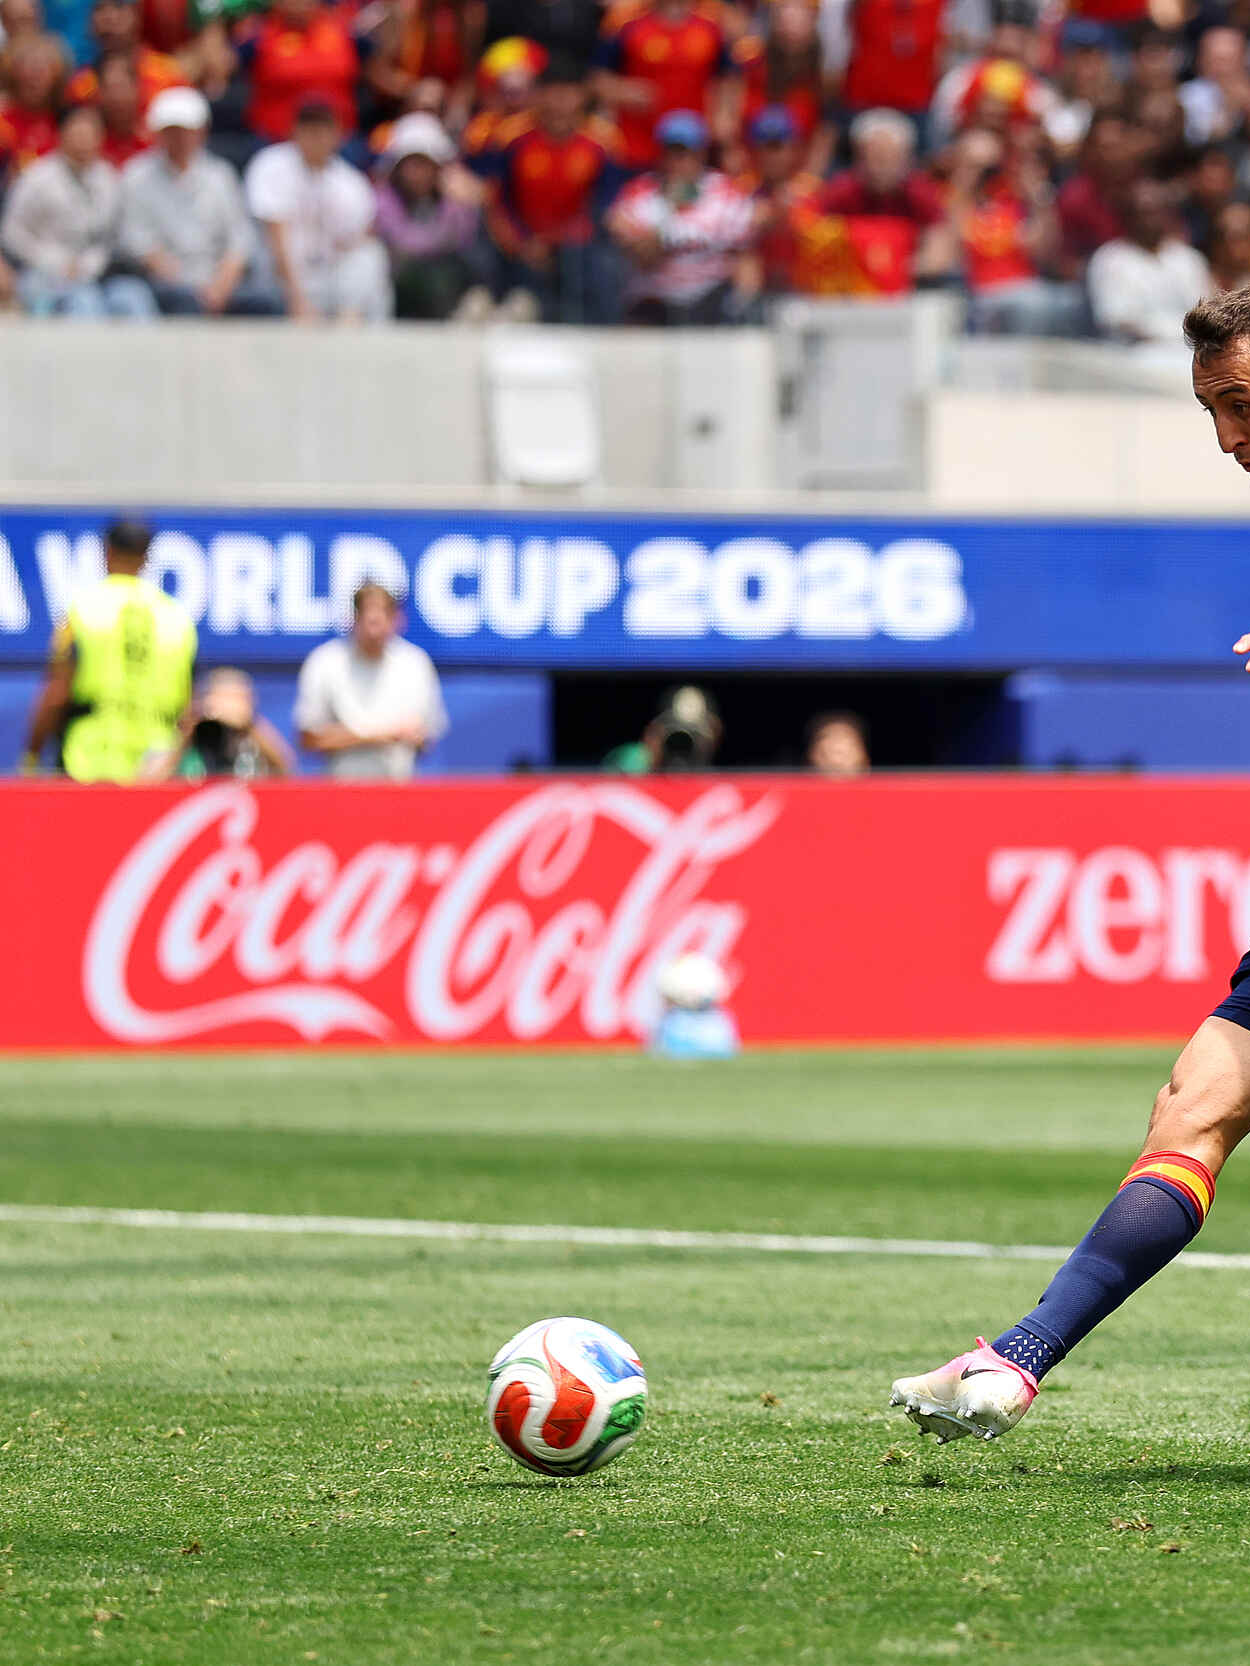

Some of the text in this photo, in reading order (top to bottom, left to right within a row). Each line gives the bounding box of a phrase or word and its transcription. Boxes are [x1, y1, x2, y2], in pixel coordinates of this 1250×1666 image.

[36, 530, 409, 635] WORLD
[416, 533, 619, 638] CUP
[624, 537, 967, 641] 2026
[82, 782, 780, 1043] Coca-Cola
